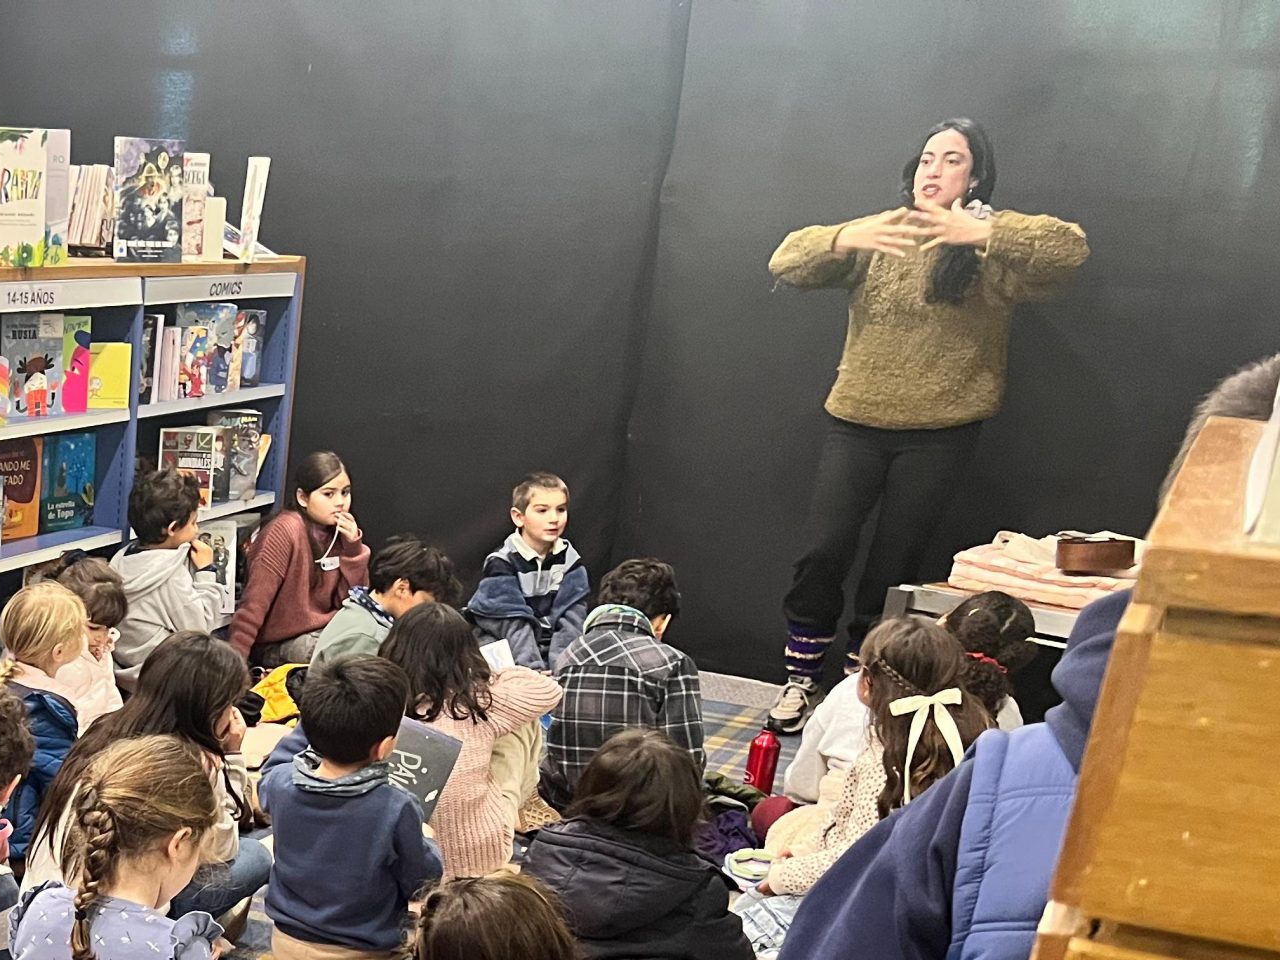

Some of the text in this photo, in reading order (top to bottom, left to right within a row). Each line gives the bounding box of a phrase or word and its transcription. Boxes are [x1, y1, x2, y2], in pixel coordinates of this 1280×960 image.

[209, 281, 243, 297] COMICS
[7, 288, 54, 304] 14-15 AÑOS
[11, 329, 37, 340] RUSIA
[20, 460, 31, 471] ME
